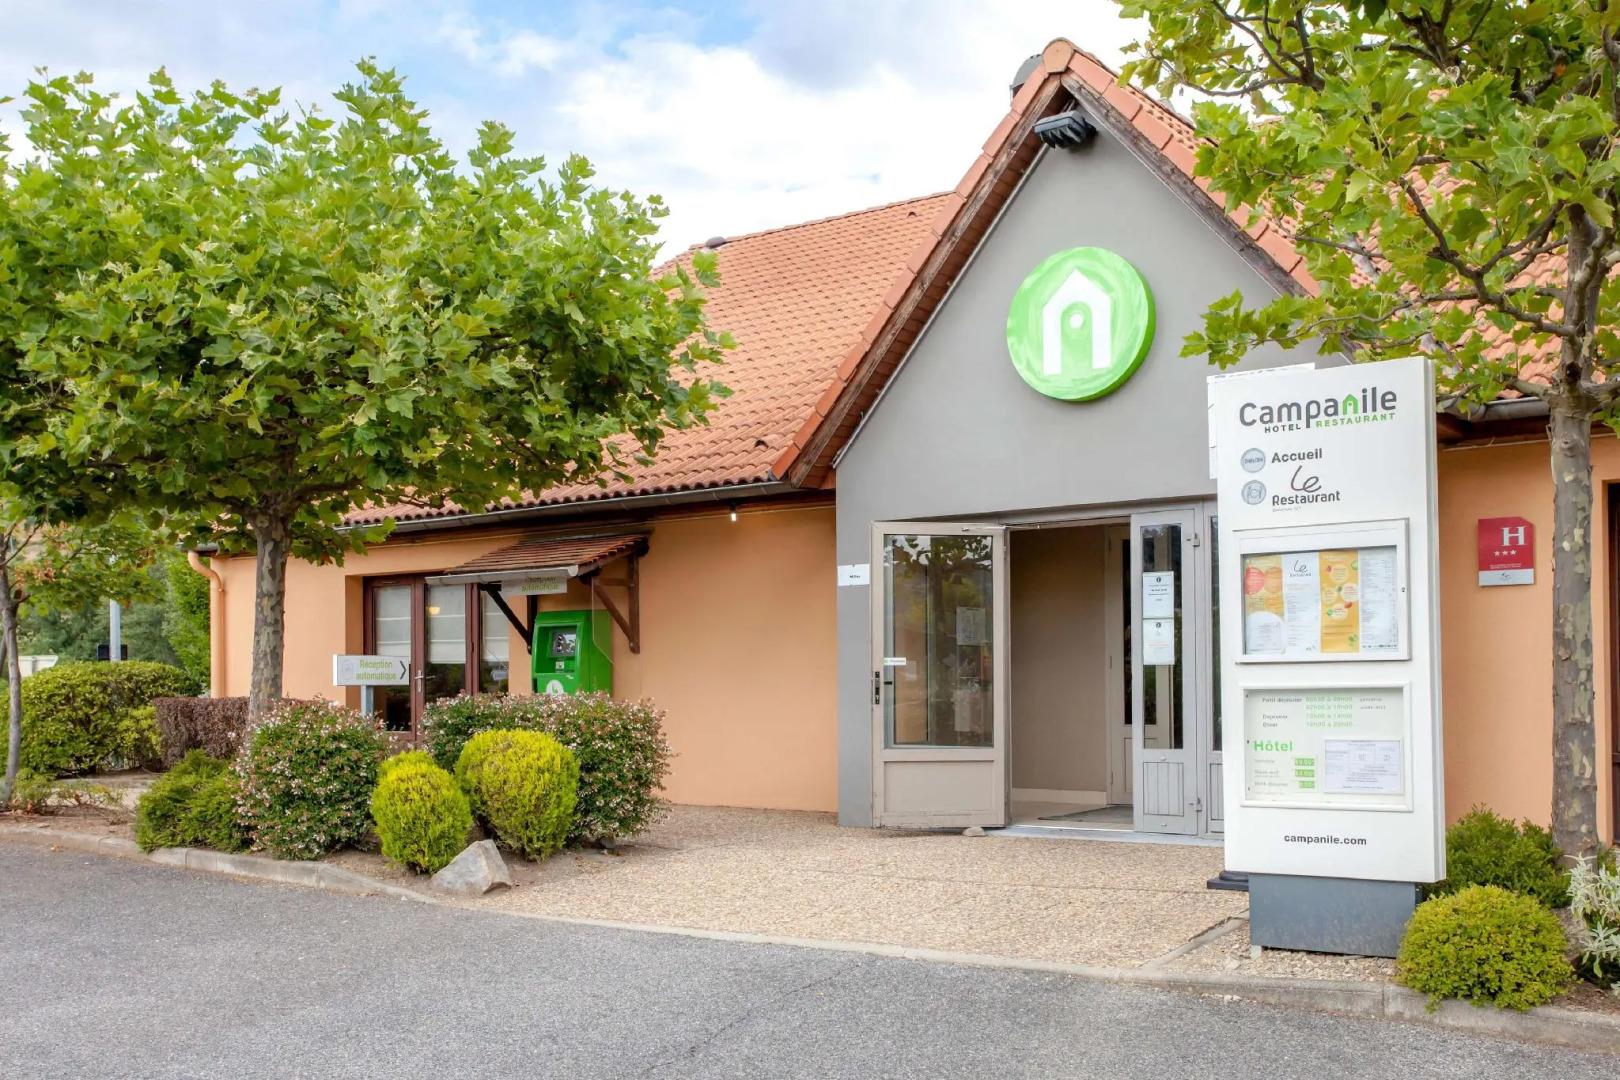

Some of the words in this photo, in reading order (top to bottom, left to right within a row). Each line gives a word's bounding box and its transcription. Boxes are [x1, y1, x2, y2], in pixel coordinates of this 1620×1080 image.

[1239, 386, 1397, 428] Campanile
[1264, 425, 1302, 434] HOTEL
[1316, 412, 1396, 428] RESTAURANT
[1271, 447, 1323, 464] Accueil
[1272, 490, 1341, 507] Restaurant
[1501, 525, 1528, 547] H
[359, 659, 393, 670] Réception
[355, 671, 397, 681] automatique
[1253, 740, 1293, 752] Hôtel
[1283, 834, 1368, 846] campanile.com
